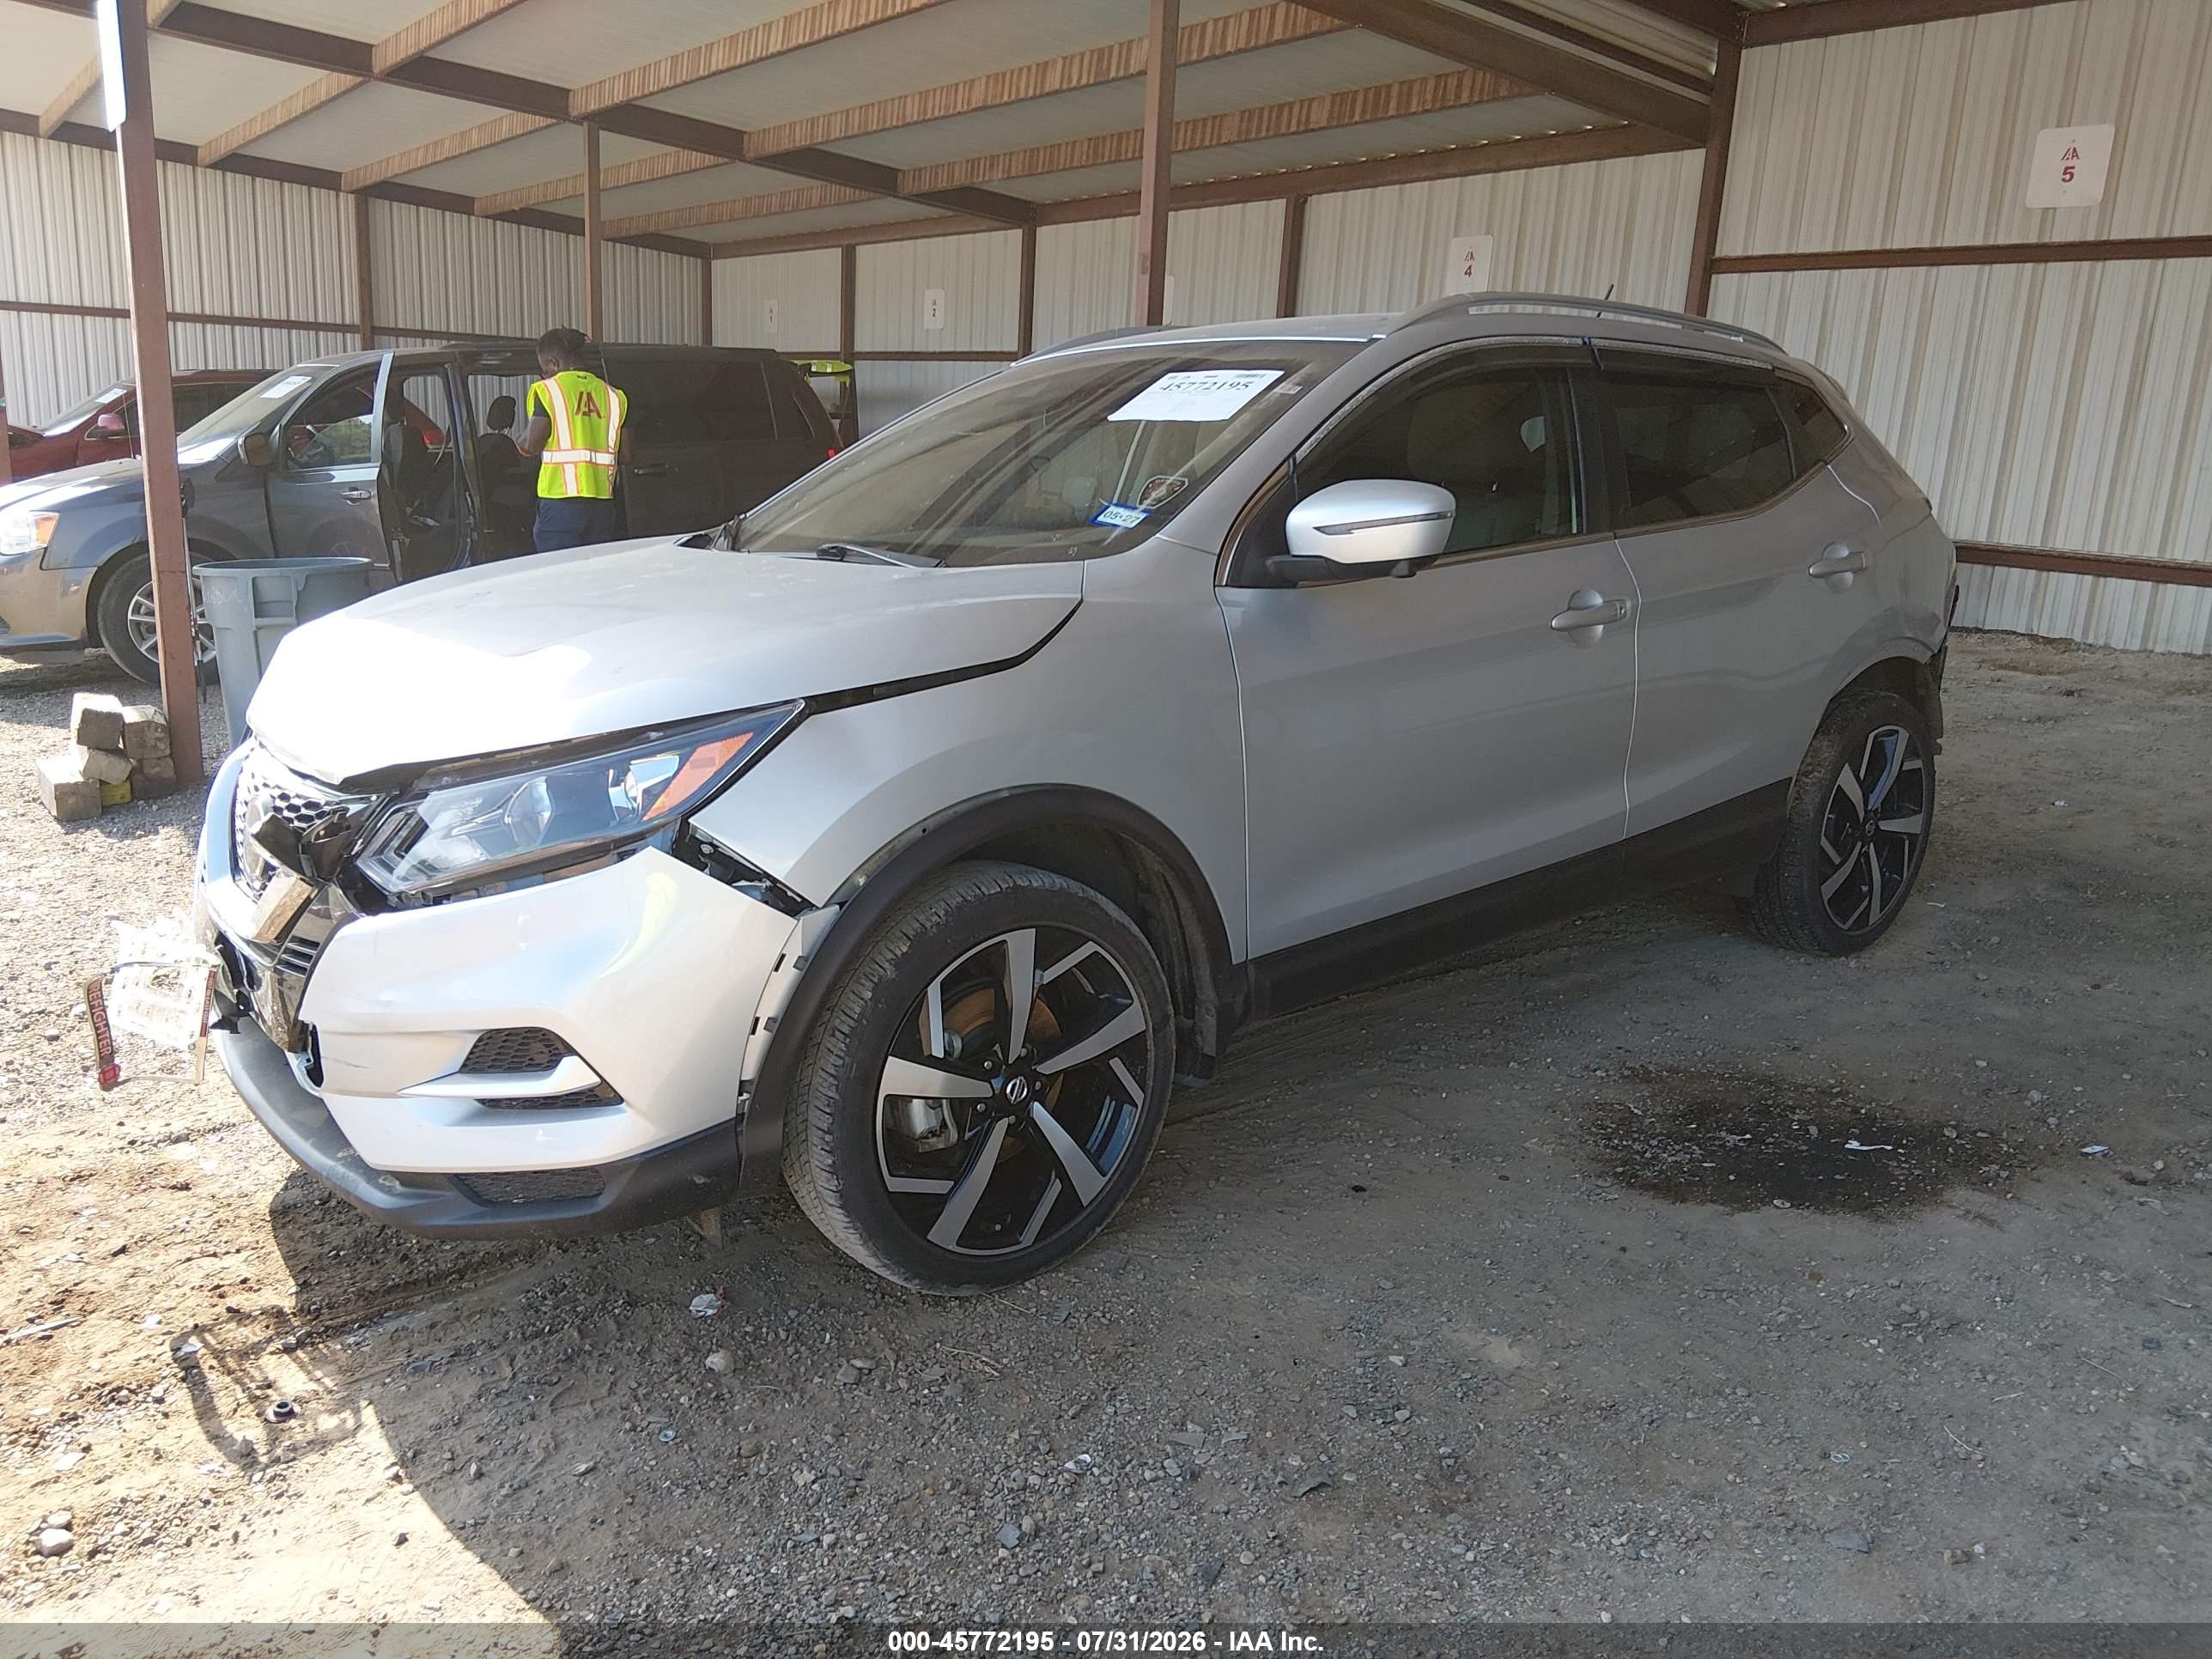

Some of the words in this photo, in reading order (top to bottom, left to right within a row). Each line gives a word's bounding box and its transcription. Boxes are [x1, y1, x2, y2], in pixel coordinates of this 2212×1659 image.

[2061, 166, 2075, 183] 5
[1464, 264, 1473, 278] 4
[1159, 380, 1255, 392] 45772195
